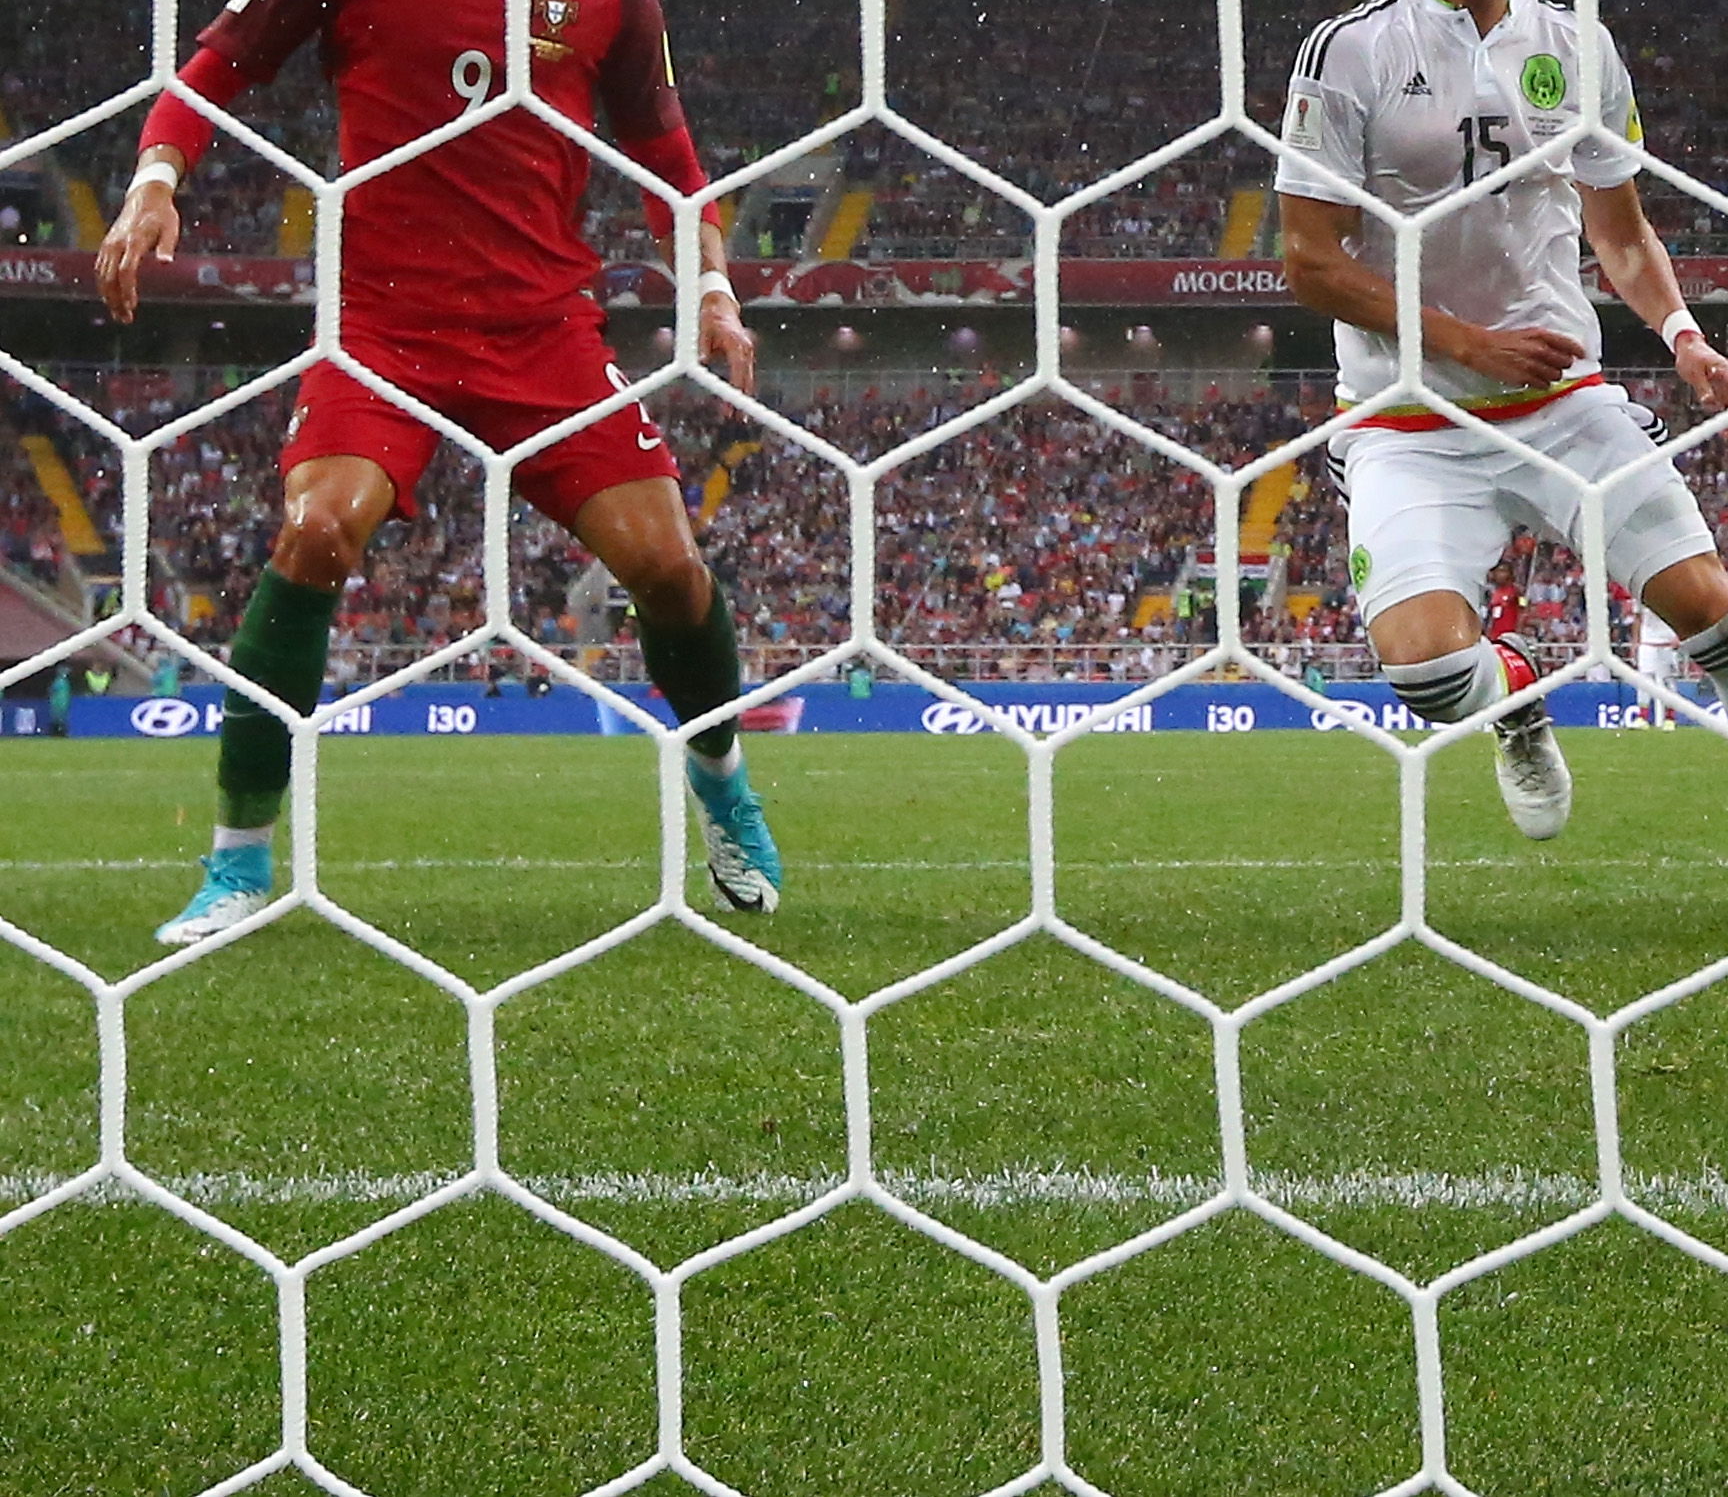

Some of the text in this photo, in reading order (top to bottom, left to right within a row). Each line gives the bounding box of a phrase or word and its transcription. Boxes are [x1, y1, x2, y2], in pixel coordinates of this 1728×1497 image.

[452, 49, 492, 115] 9
[1457, 115, 1511, 195] 15
[427, 704, 477, 733] i30
[1206, 704, 1256, 732] i30
